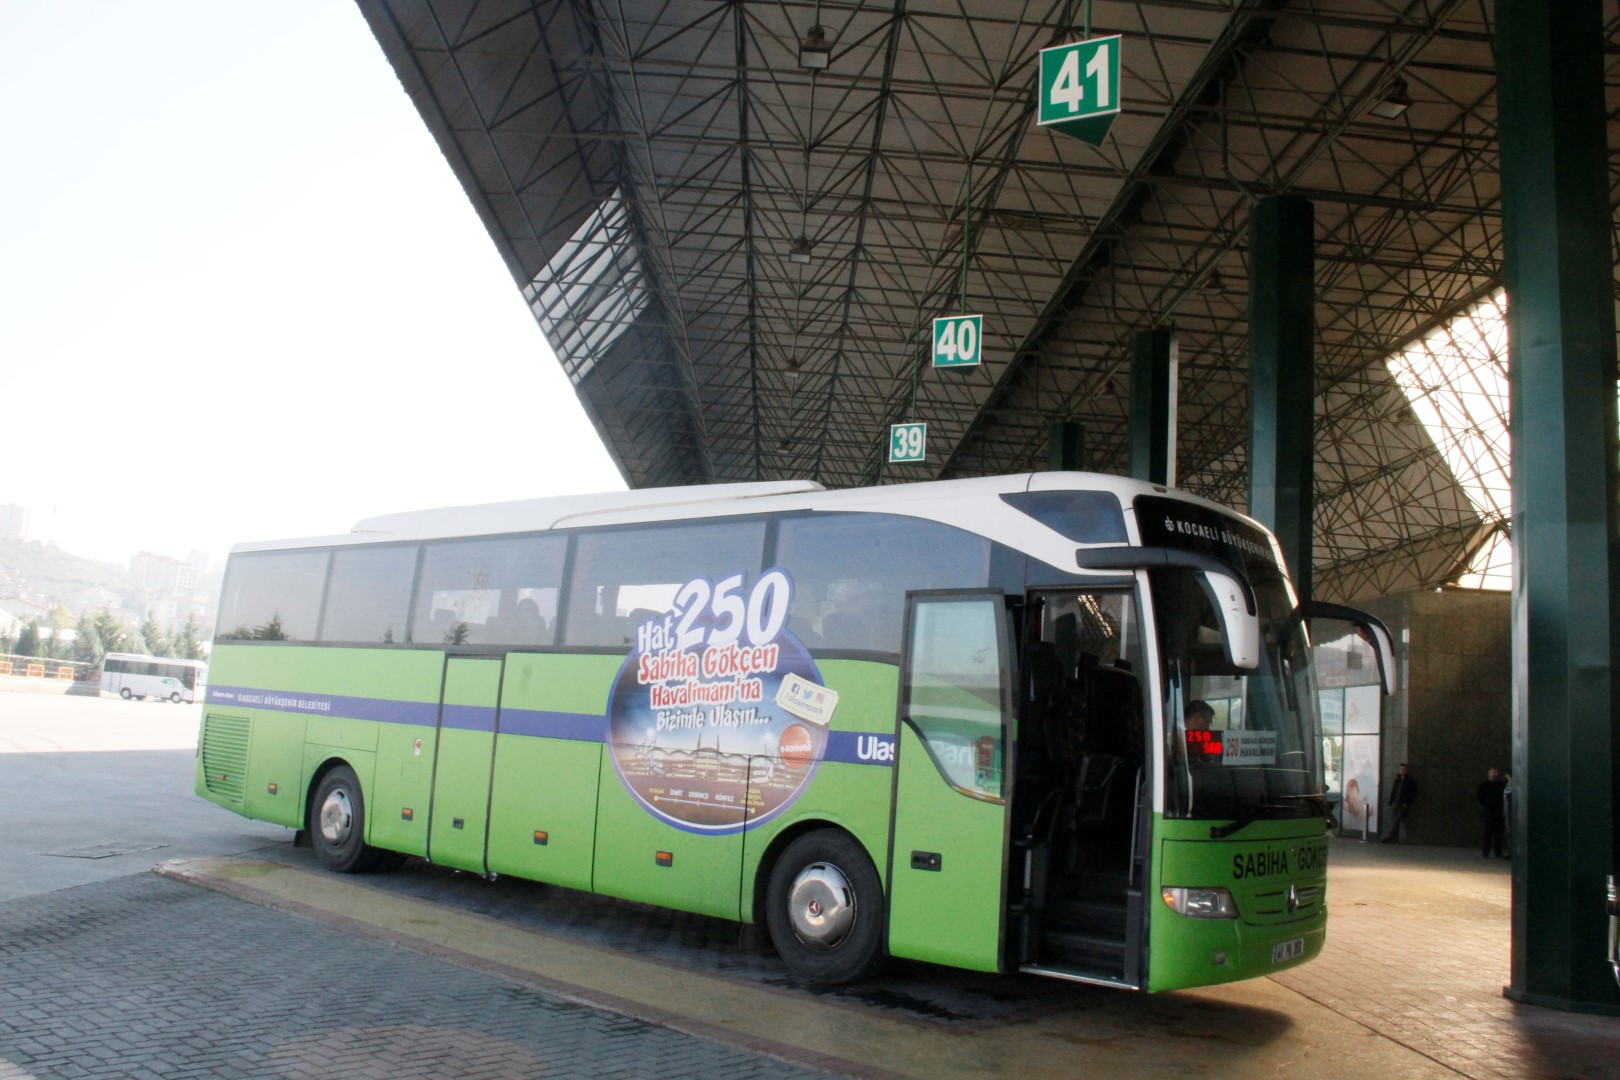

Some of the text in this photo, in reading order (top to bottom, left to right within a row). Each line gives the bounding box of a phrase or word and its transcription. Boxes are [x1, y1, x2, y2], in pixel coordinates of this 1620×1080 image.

[1050, 43, 1109, 113] 41
[936, 319, 977, 361] 40
[893, 426, 923, 458] 39
[1176, 520, 1220, 541] KOCAELİ
[637, 571, 790, 653] Hat 250
[639, 643, 778, 683] Sabiha Gökçen
[651, 677, 761, 706] Havalimanı'na
[656, 706, 704, 731] Bizimle
[1226, 737, 1239, 757] 250
[1233, 845, 1289, 880] SABİHA
